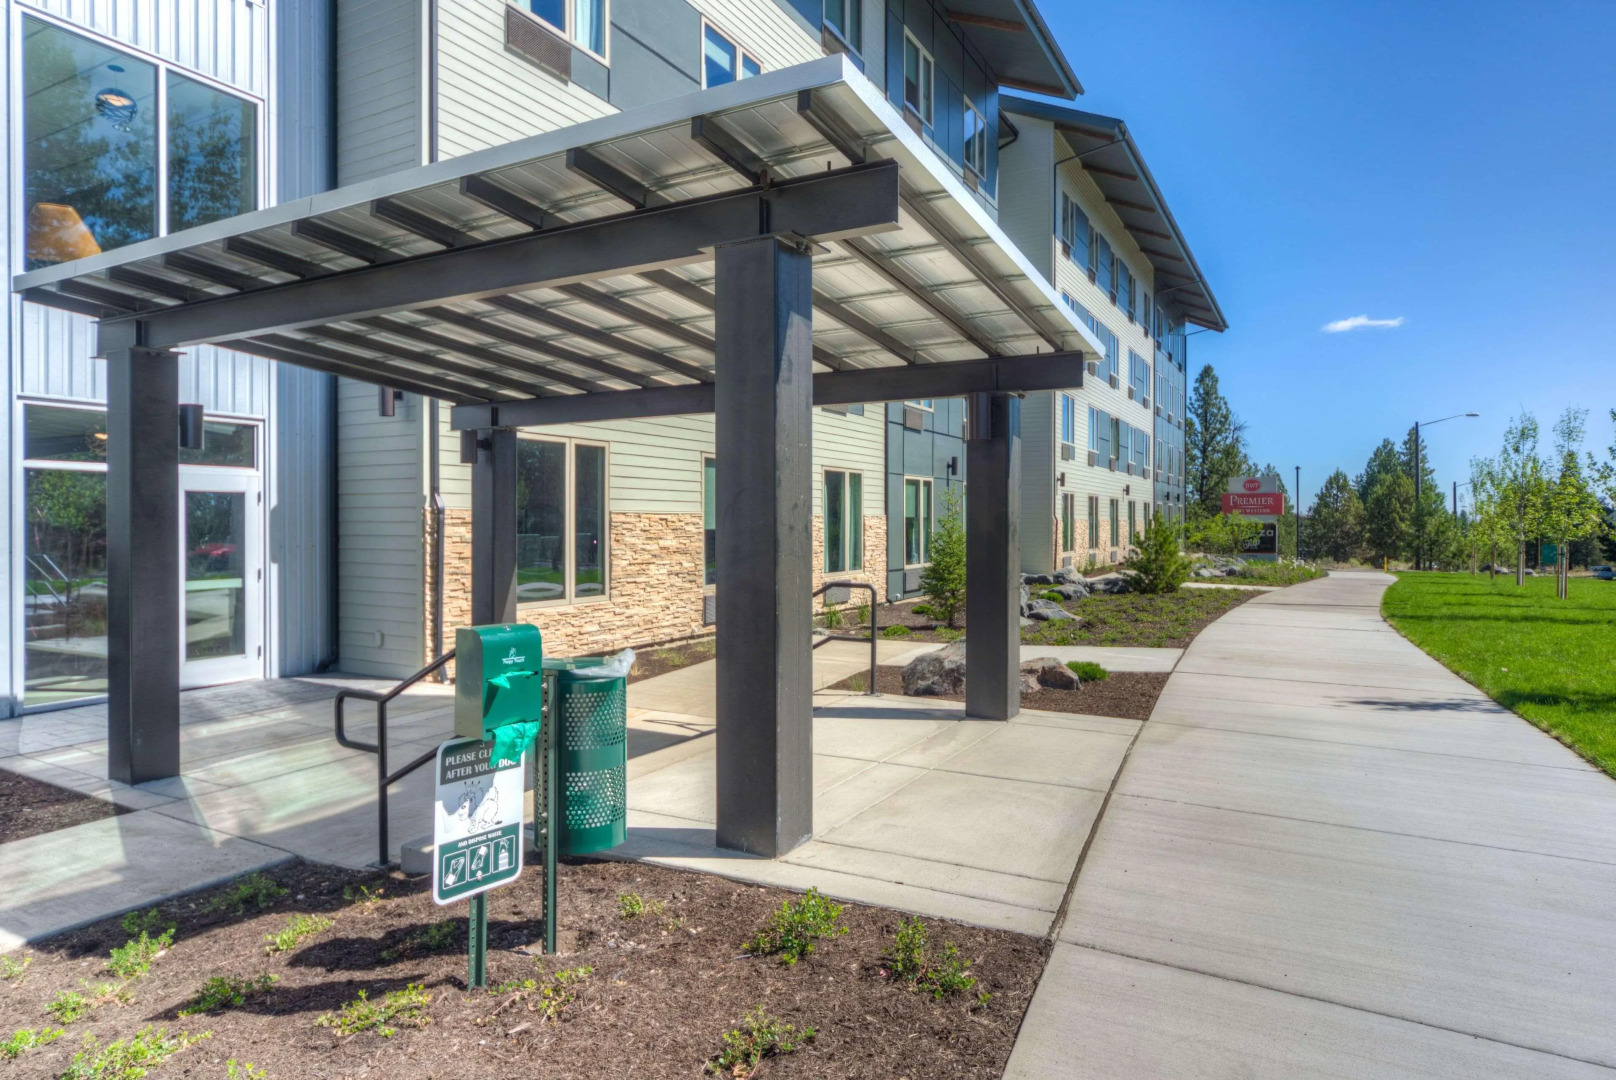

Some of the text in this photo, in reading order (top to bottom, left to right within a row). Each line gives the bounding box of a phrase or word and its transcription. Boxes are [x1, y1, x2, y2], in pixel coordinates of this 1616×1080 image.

[1230, 495, 1274, 506] PREMIER
[445, 751, 477, 766] PLEASE
[445, 766, 472, 780] AFTER
